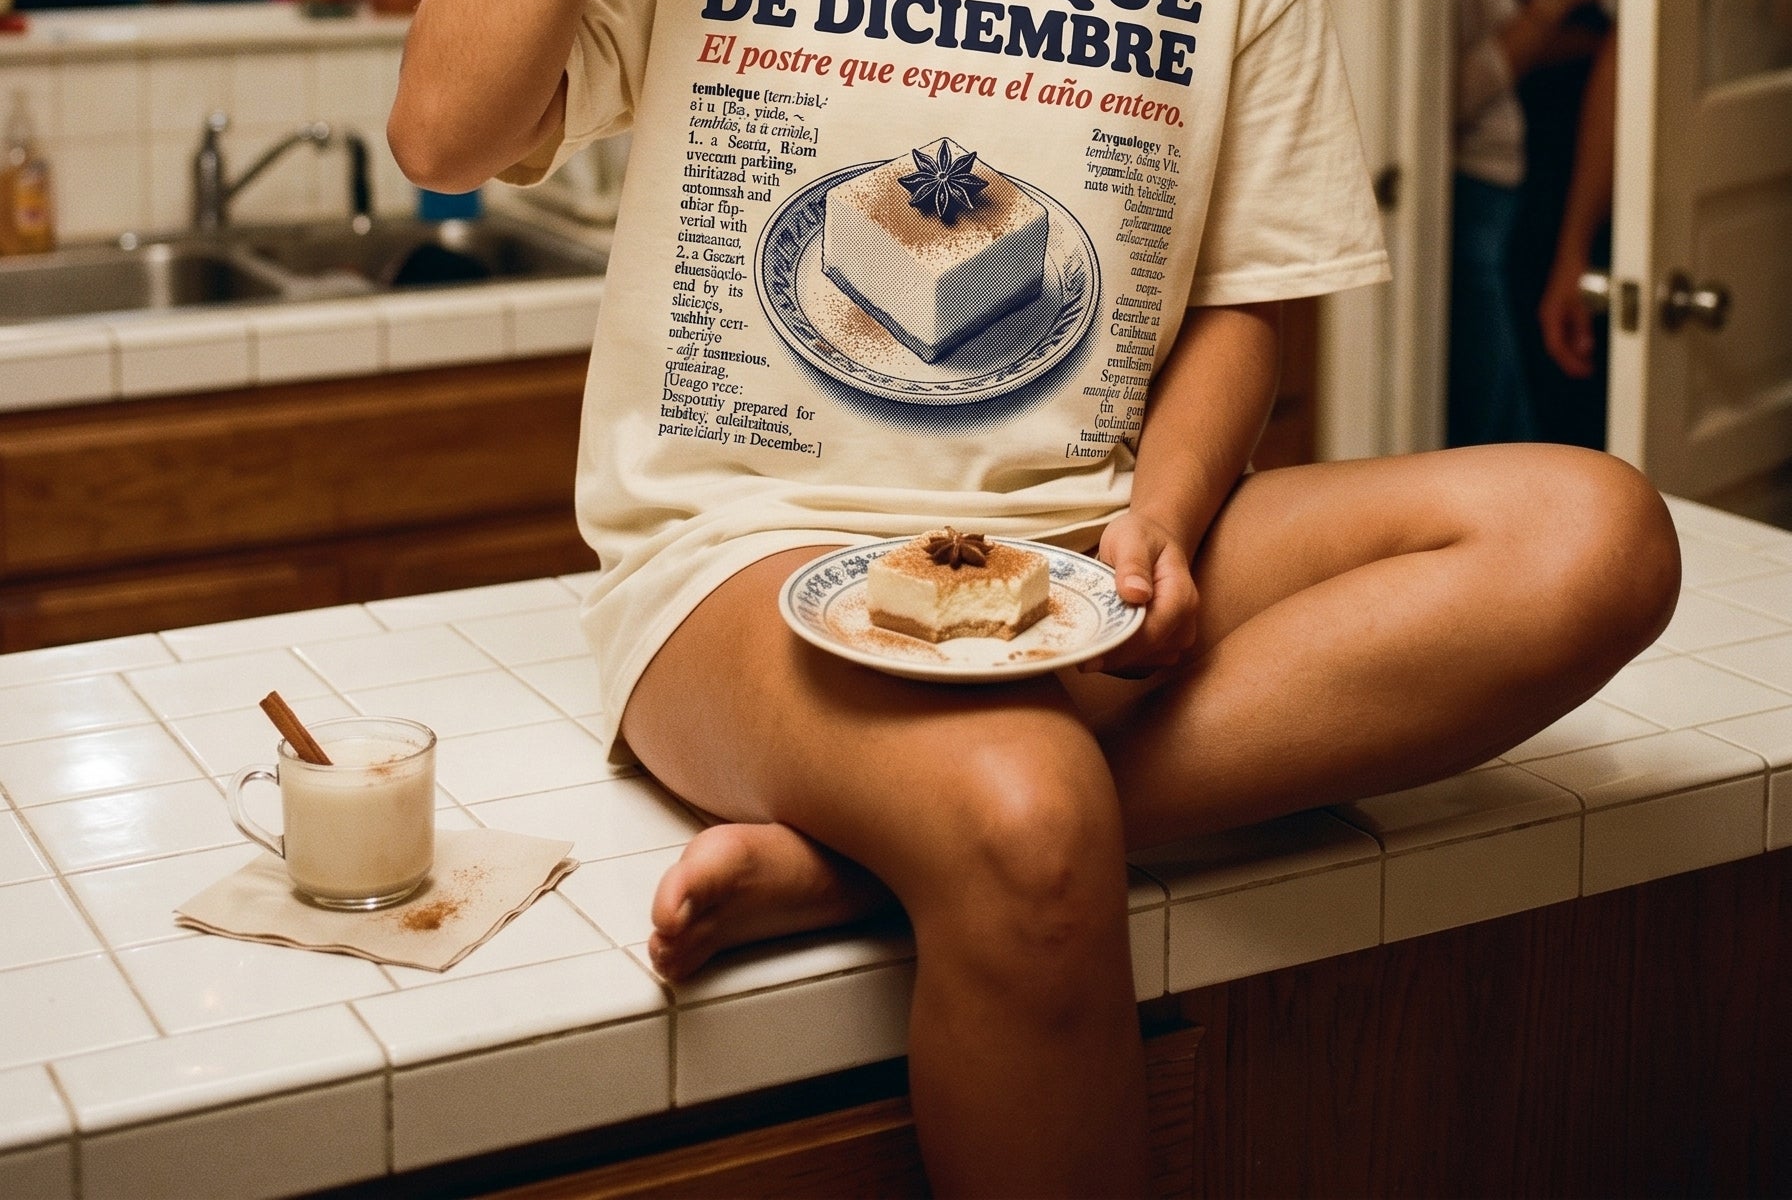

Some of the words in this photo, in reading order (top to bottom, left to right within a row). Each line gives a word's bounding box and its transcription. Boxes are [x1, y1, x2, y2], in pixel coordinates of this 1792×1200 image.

[697, 34, 736, 65] El
[738, 43, 832, 77] postre
[840, 54, 893, 90] que
[902, 66, 996, 100] espera
[1005, 72, 1033, 102] el
[1037, 79, 1093, 110] año
[1099, 91, 1185, 129] entero.
[692, 82, 760, 100] tembleque
[710, 136, 718, 146] a
[752, 173, 780, 187] with
[747, 189, 771, 202] and
[1111, 182, 1134, 197] with
[720, 218, 747, 233] with
[676, 245, 689, 260] 2.
[691, 250, 699, 260] a
[673, 279, 695, 292] end
[728, 284, 743, 298] its
[733, 400, 788, 418] prepared
[796, 406, 816, 421] for
[734, 431, 745, 443] in
